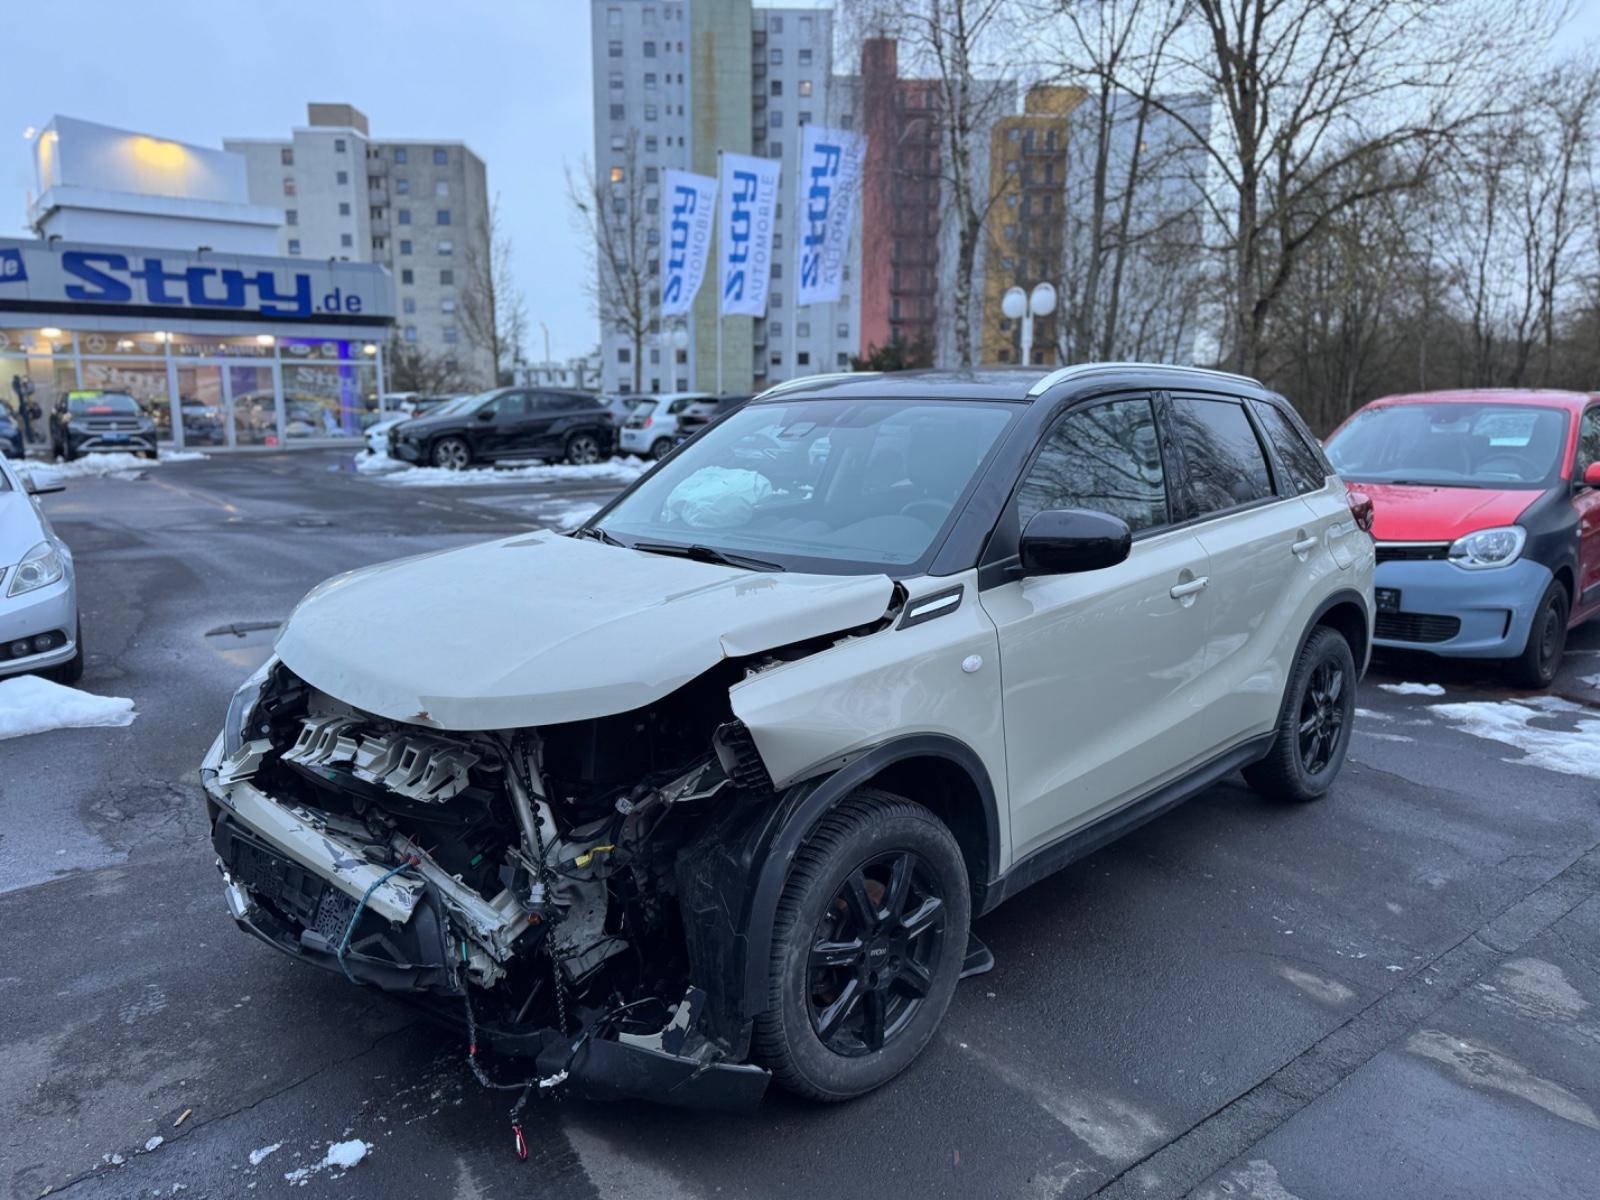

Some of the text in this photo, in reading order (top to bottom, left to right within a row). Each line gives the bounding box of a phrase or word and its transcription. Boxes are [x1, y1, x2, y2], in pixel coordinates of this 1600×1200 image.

[663, 185, 697, 303] Stoy
[724, 170, 757, 301] Stoy
[750, 174, 774, 302] AUTOMOBILE
[801, 144, 842, 288] Stoy
